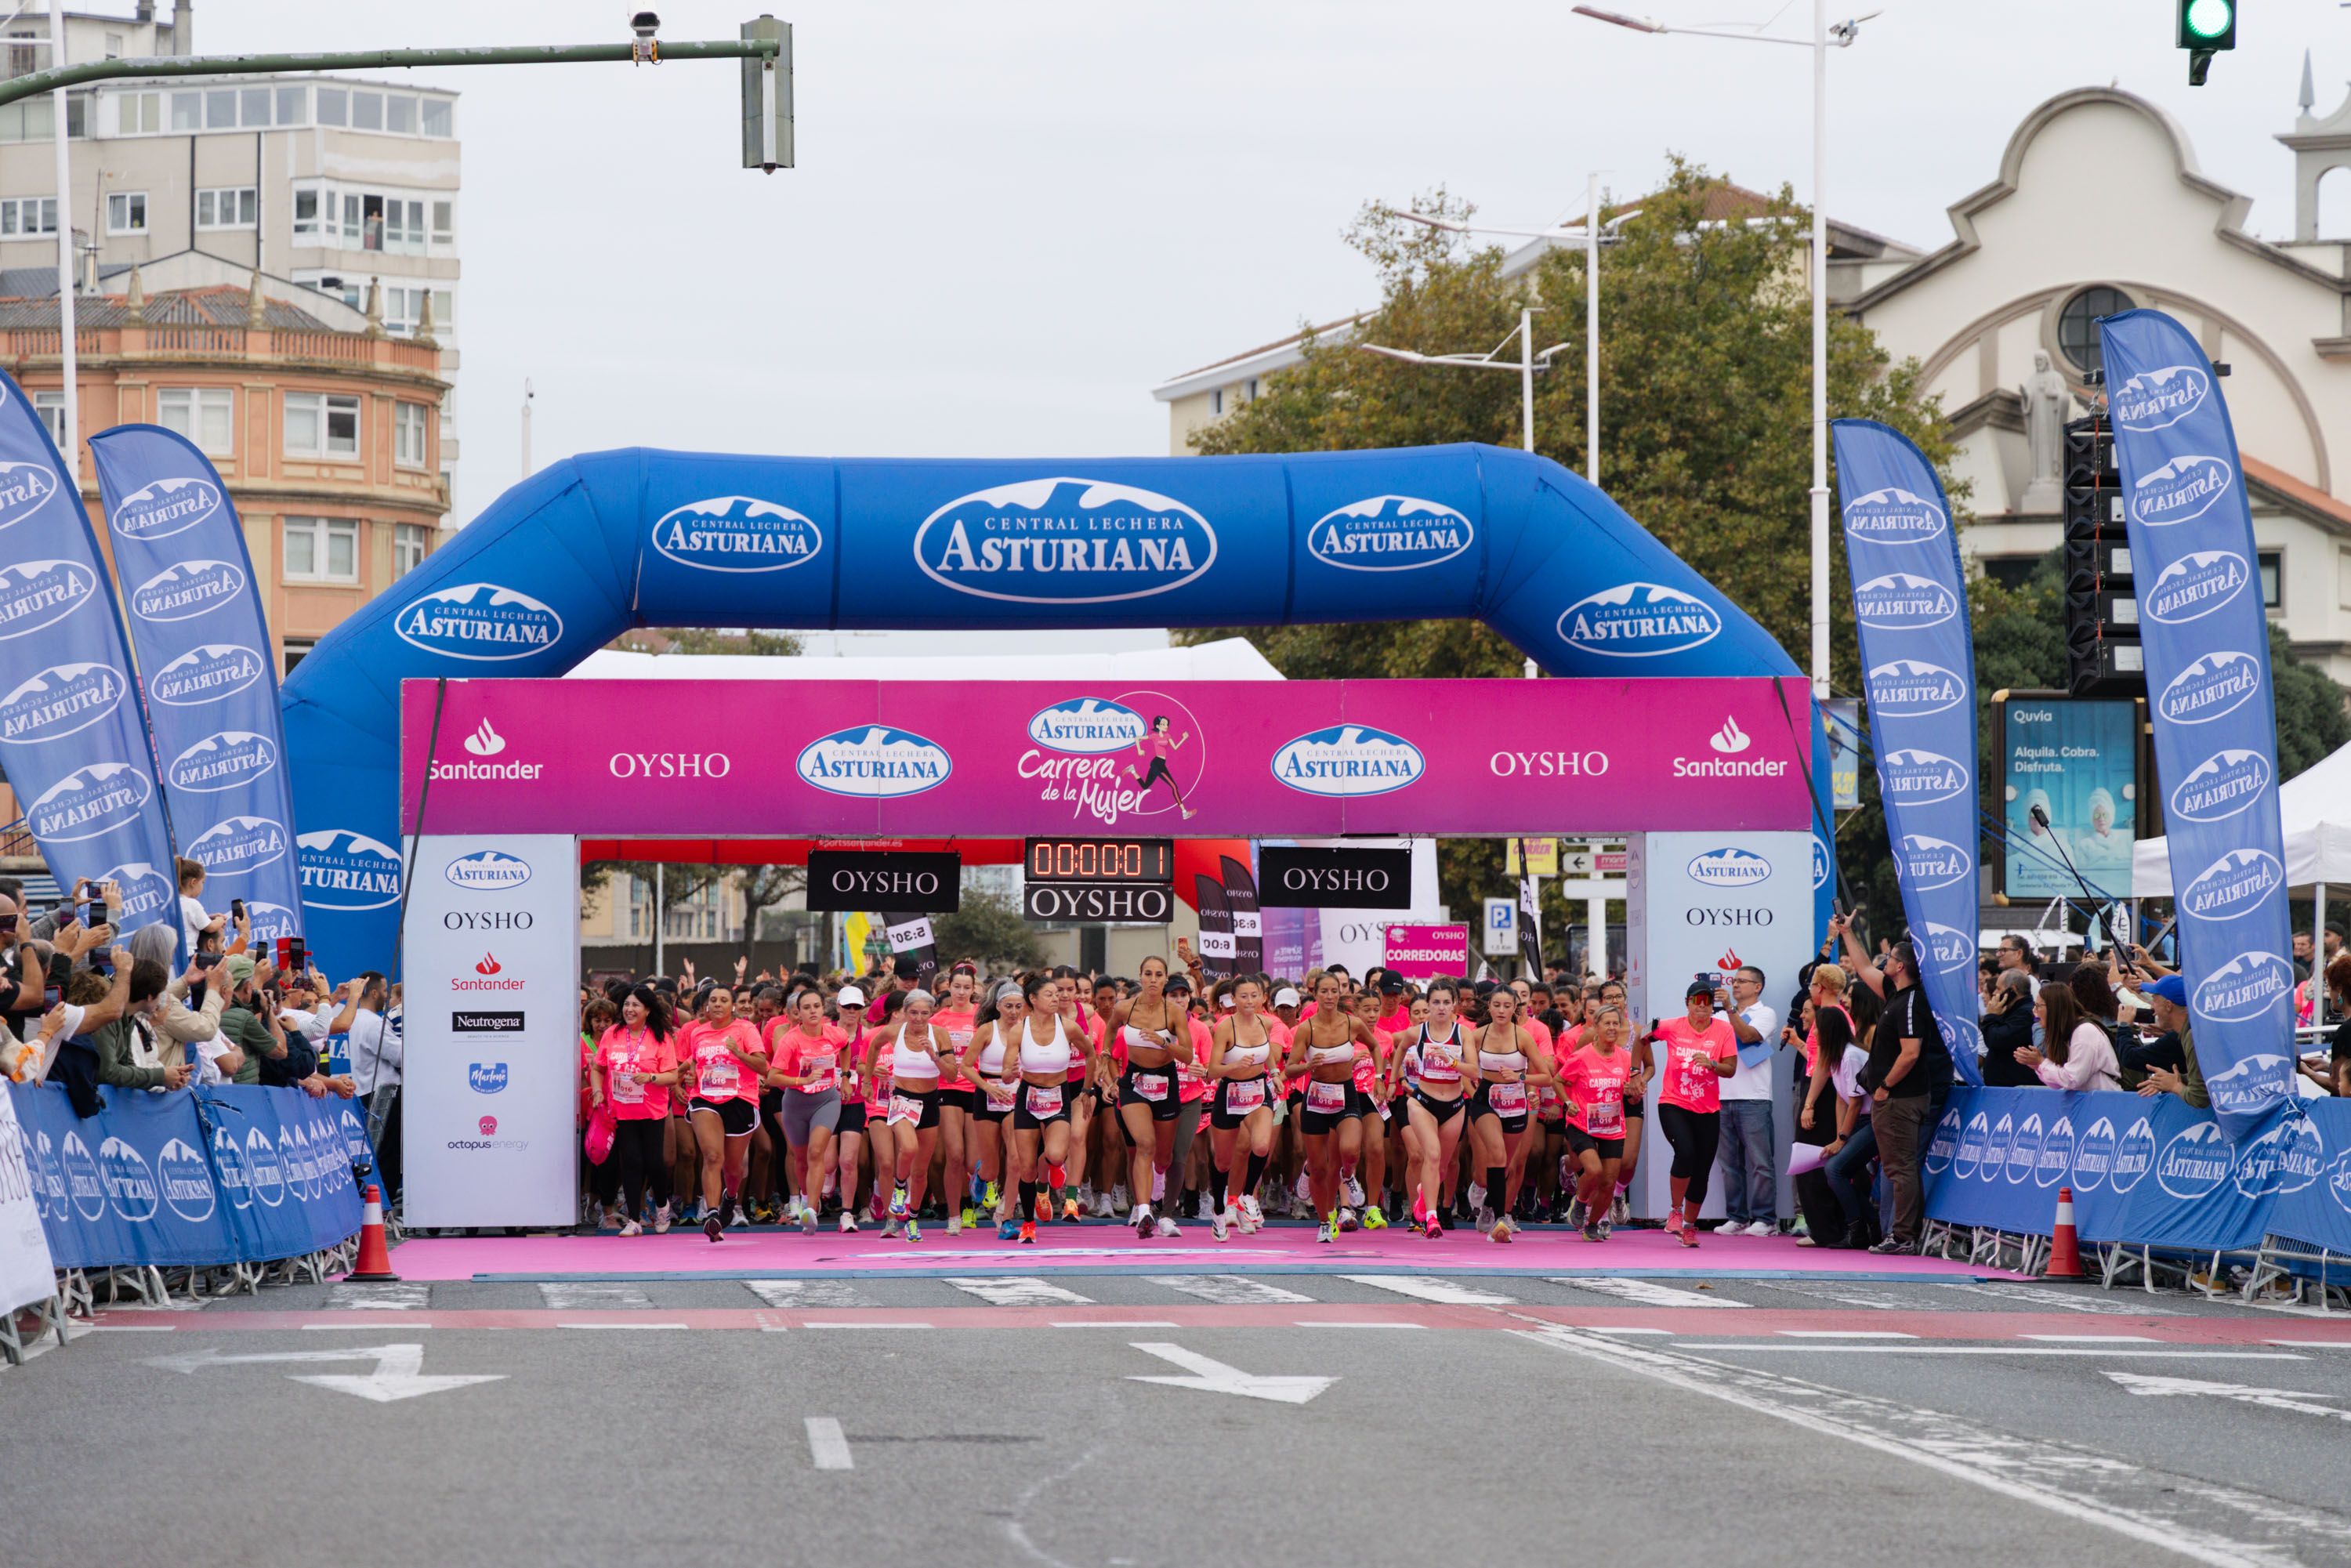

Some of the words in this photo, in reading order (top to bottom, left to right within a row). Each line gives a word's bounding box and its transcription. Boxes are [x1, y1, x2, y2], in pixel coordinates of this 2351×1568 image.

[692, 520, 745, 529] CENTRAL
[750, 522, 804, 531] LECHERA
[985, 517, 1078, 531] CENTRAL
[1089, 517, 1183, 531] LECHERA
[1346, 520, 1398, 531] CENTRAL
[1403, 518, 1455, 528] LECHERA
[665, 520, 809, 554] ASTURIANA
[936, 520, 1194, 572] ASTURIANA
[1320, 524, 1461, 554] ASTURIANA
[434, 607, 488, 617] CENTRAL
[494, 611, 548, 622] LECHERA
[1595, 607, 1649, 618] CENTRAL
[1654, 604, 1703, 614] LECHERA
[406, 608, 549, 643] ASTURIANA
[1570, 614, 1712, 640] ASTURIANA
[2014, 710, 2052, 723] Quvia
[1038, 718, 1136, 739] ASTURIANA
[2015, 747, 2059, 759] Alquila.
[2061, 746, 2099, 757] Cobra.
[429, 759, 543, 780] Santander
[610, 753, 730, 777] OYSHO
[809, 751, 940, 778] ASTURIANA
[1018, 749, 1115, 779] Carrera
[1283, 751, 1413, 777] ASTURIANA
[1491, 751, 1609, 776] OYSHO
[1673, 757, 1787, 777] Santander
[2015, 761, 2065, 773] Disfruta.
[1041, 780, 1060, 801] de
[1063, 780, 1077, 801] la
[1073, 776, 1152, 824] Mujer
[350, 857, 399, 871] LECHERA
[1035, 844, 1163, 875] 00:00:01
[452, 865, 525, 880] ASTURIANA
[1694, 862, 1765, 877] ASTURIANA
[832, 870, 939, 894] OYSHO
[1284, 868, 1389, 891] OYSHO
[1031, 889, 1167, 918] OYSHO
[444, 912, 533, 929] OYSHO
[1493, 907, 1507, 926] P
[1686, 908, 1773, 926] OYSHO
[1433, 931, 1465, 940] OYSHO
[1386, 949, 1465, 962] CORREDORAS
[451, 978, 525, 990] Santander
[458, 1016, 520, 1030] Neutrogena
[471, 1069, 505, 1085] Marlene
[1589, 1077, 1621, 1088] CARRERA
[447, 1140, 491, 1150] octopus
[492, 1140, 529, 1151] energy
[2161, 1148, 2226, 1180] ASTURIANA
